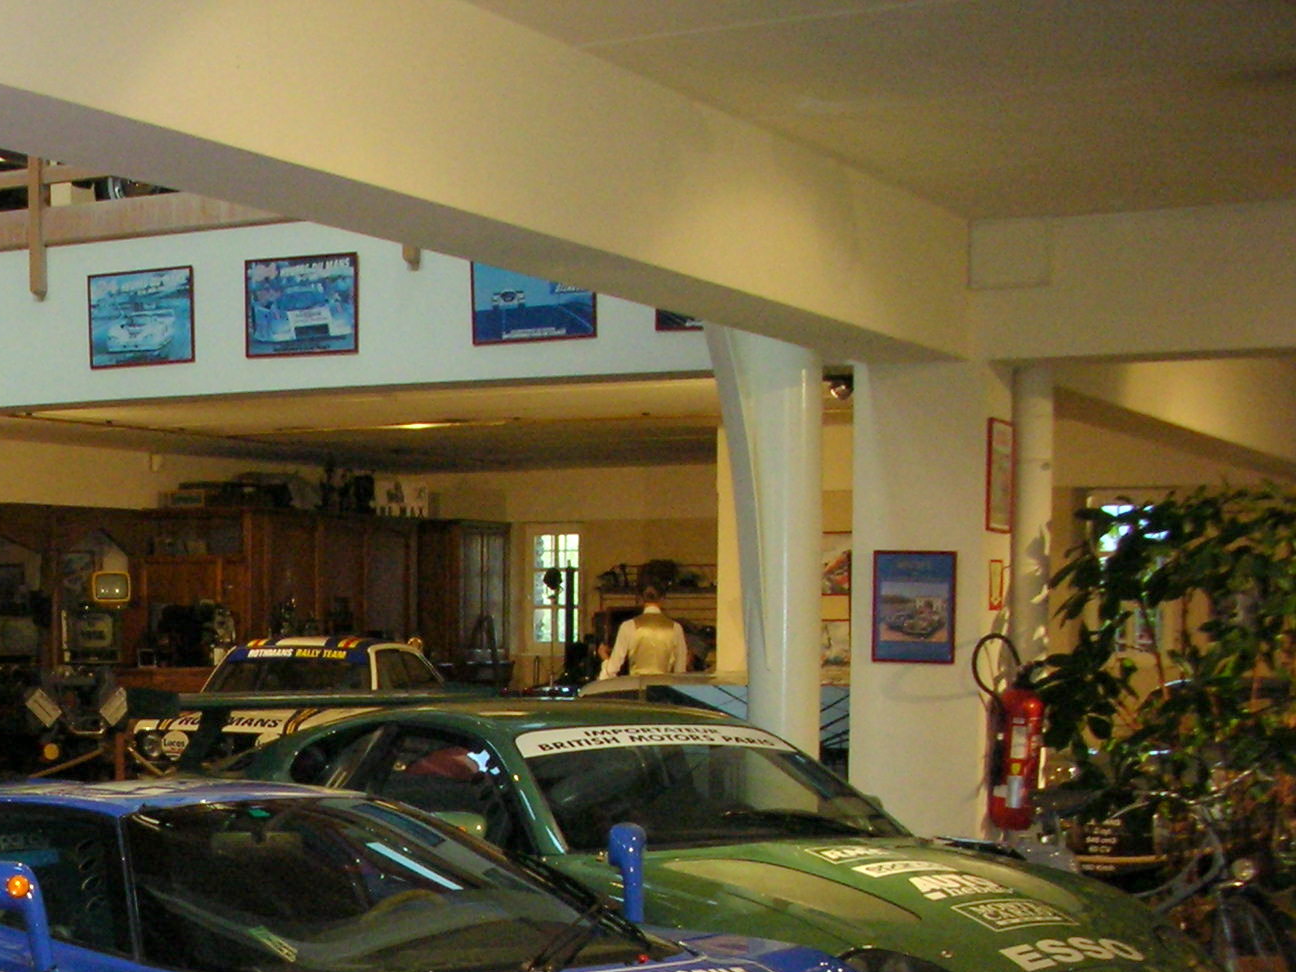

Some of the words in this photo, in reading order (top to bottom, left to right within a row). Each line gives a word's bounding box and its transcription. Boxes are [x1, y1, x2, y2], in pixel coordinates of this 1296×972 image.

[538, 735, 620, 752] BRITISH
[629, 733, 715, 744] MOTORS
[722, 736, 776, 747] PARIS
[999, 936, 1145, 972] ESSO
